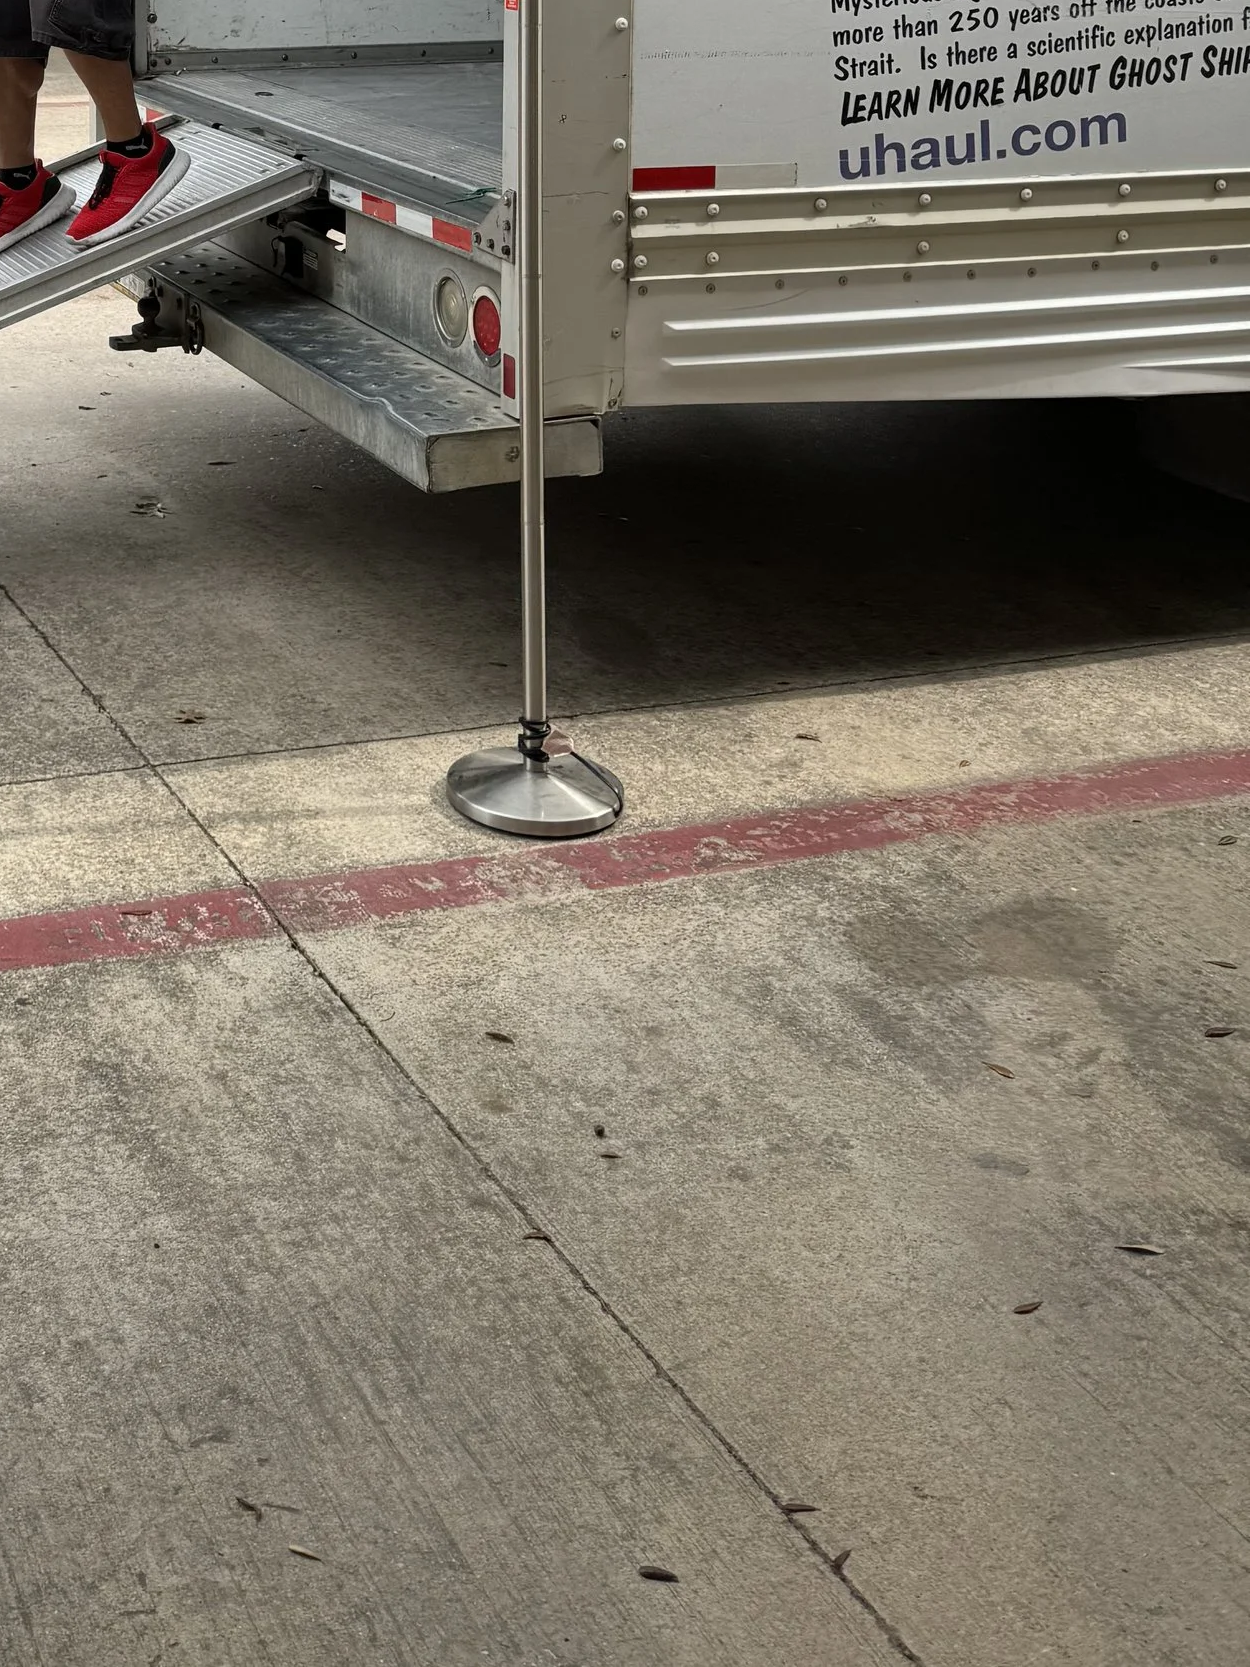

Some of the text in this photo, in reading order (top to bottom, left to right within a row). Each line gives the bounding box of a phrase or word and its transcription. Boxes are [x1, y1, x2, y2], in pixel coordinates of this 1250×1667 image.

[833, 25, 884, 47] more
[893, 14, 938, 39] than
[949, 6, 999, 32] 250
[1008, 5, 1060, 31] years
[833, 52, 902, 81] Strait.
[920, 45, 937, 70] Is
[946, 41, 998, 67] there
[1007, 42, 1017, 59] a
[1027, 24, 1116, 57] scientific
[1124, 13, 1234, 48] explanation
[840, 85, 921, 126] LEARN
[929, 76, 1005, 113] MORE
[1013, 63, 1101, 103] ABOUT
[1109, 51, 1194, 90] GHOST
[838, 111, 1128, 180] uhaul.com
